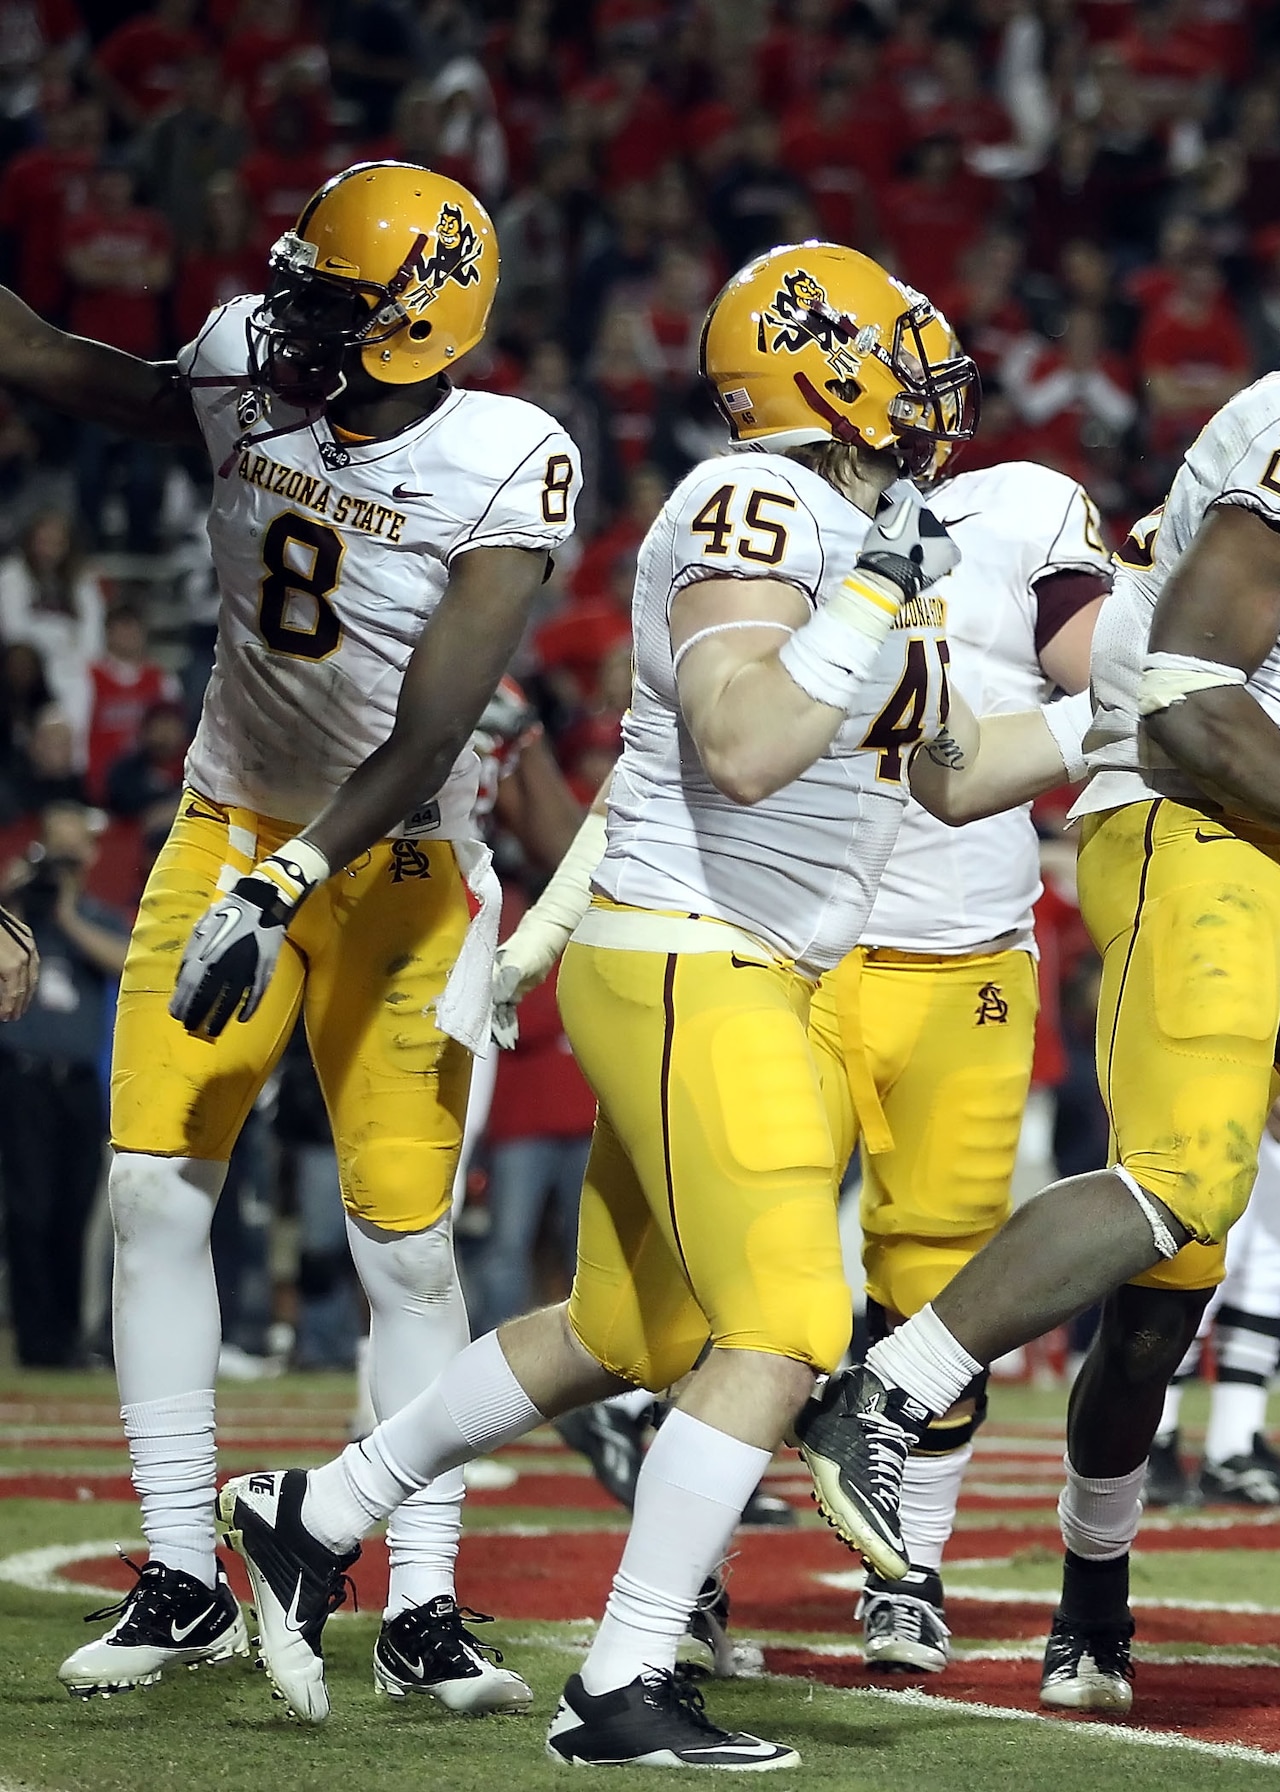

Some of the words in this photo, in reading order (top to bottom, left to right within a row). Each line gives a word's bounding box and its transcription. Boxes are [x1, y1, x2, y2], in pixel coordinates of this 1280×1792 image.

[238, 449, 333, 515] ARIZONA
[333, 493, 408, 544] STATE
[541, 453, 574, 525] 8
[689, 483, 798, 567] 45
[259, 506, 348, 664] 8
[411, 809, 434, 824] 44
